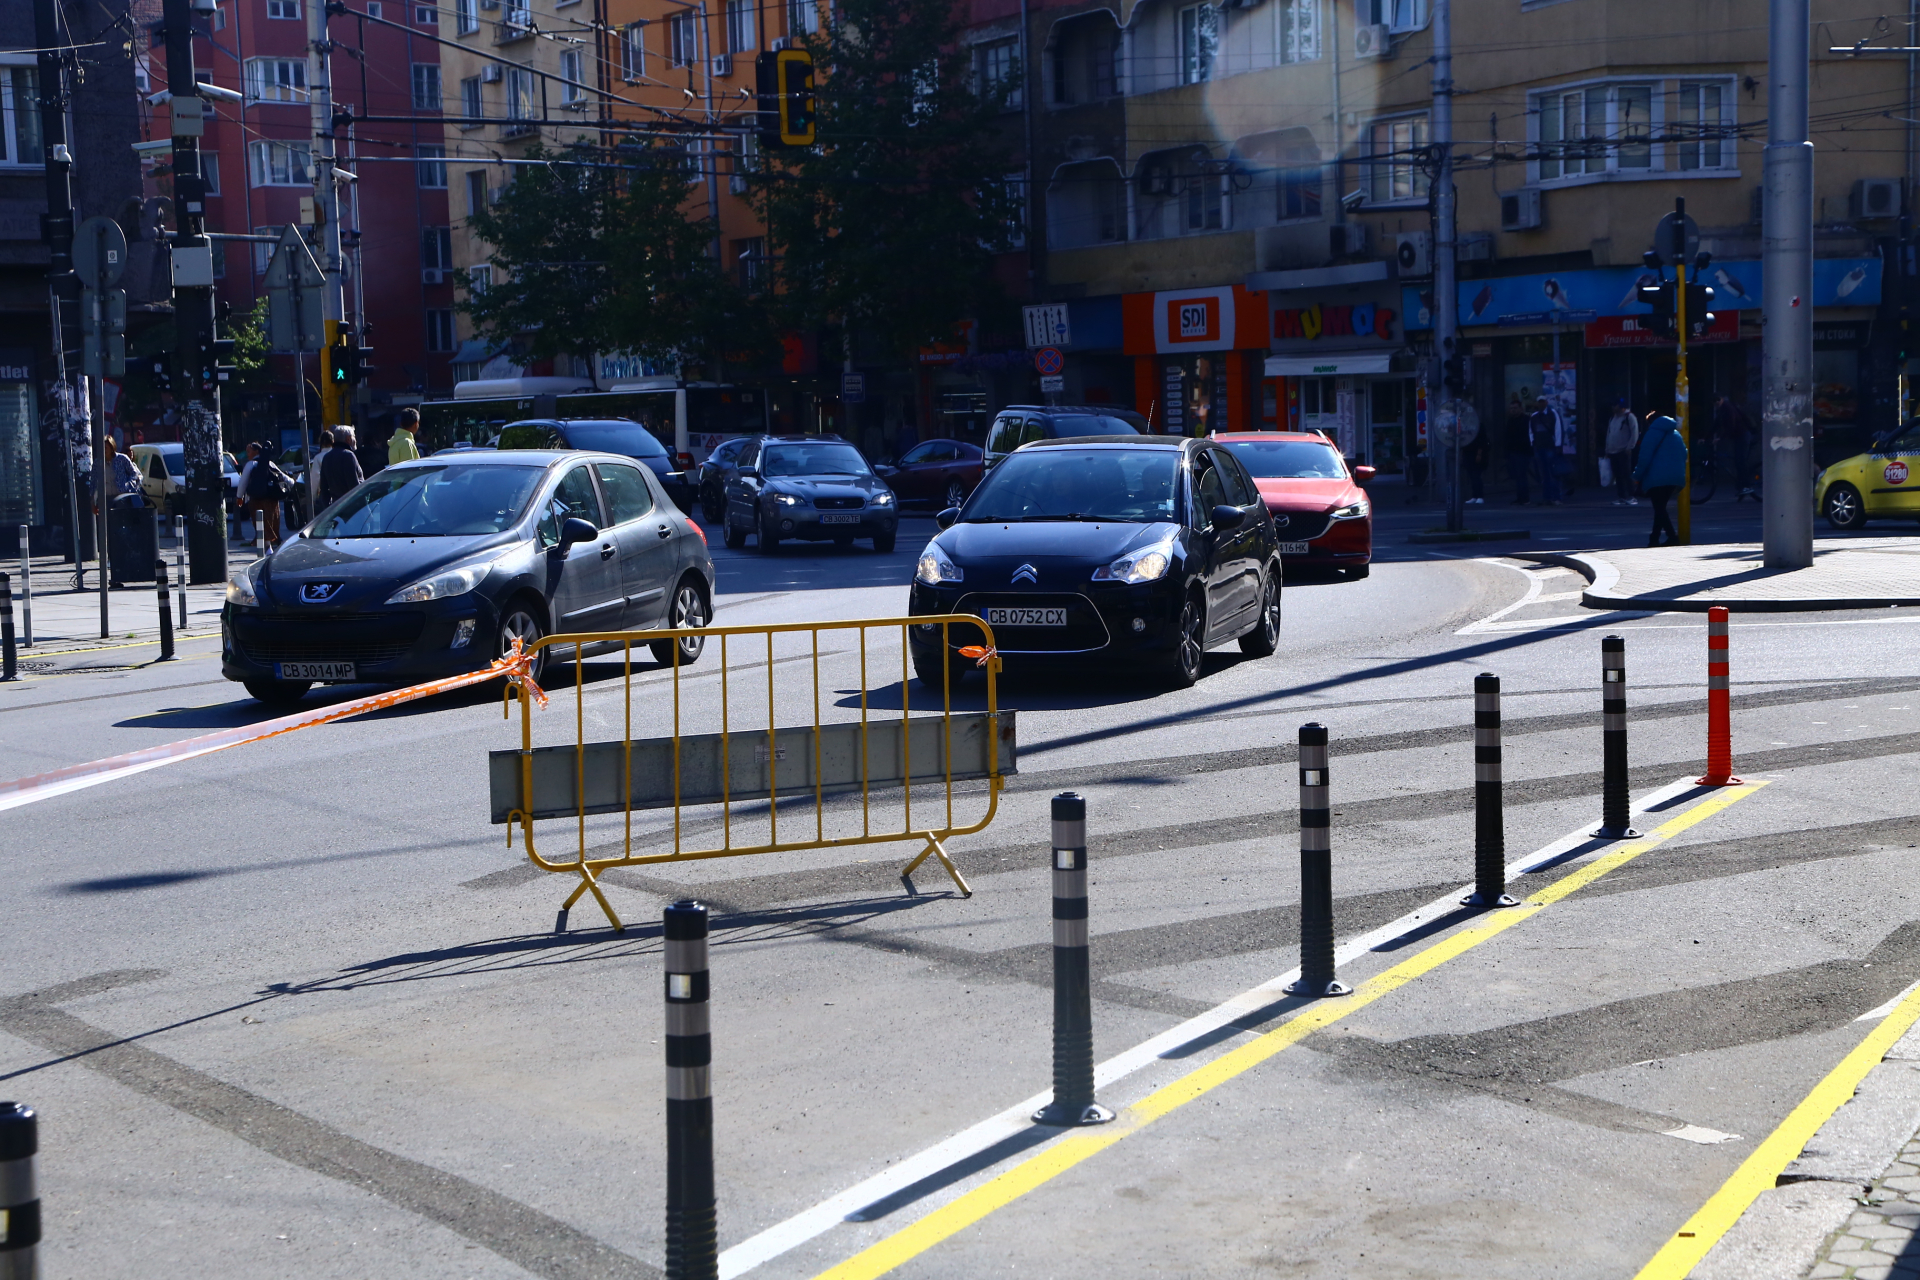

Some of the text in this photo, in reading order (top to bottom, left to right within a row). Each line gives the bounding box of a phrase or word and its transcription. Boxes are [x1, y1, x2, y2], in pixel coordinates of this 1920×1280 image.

[1182, 307, 1205, 328] SDI
[1601, 333, 1632, 347] Храни
[1827, 328, 1856, 340] СТОКИ
[0, 365, 29, 379] tlet
[1885, 468, 1907, 480] 91280
[1295, 543, 1307, 552] HK
[990, 609, 1064, 624] CB 0752 CX
[283, 664, 300, 678] CB
[302, 664, 333, 678] 3014
[335, 663, 352, 678] MP
